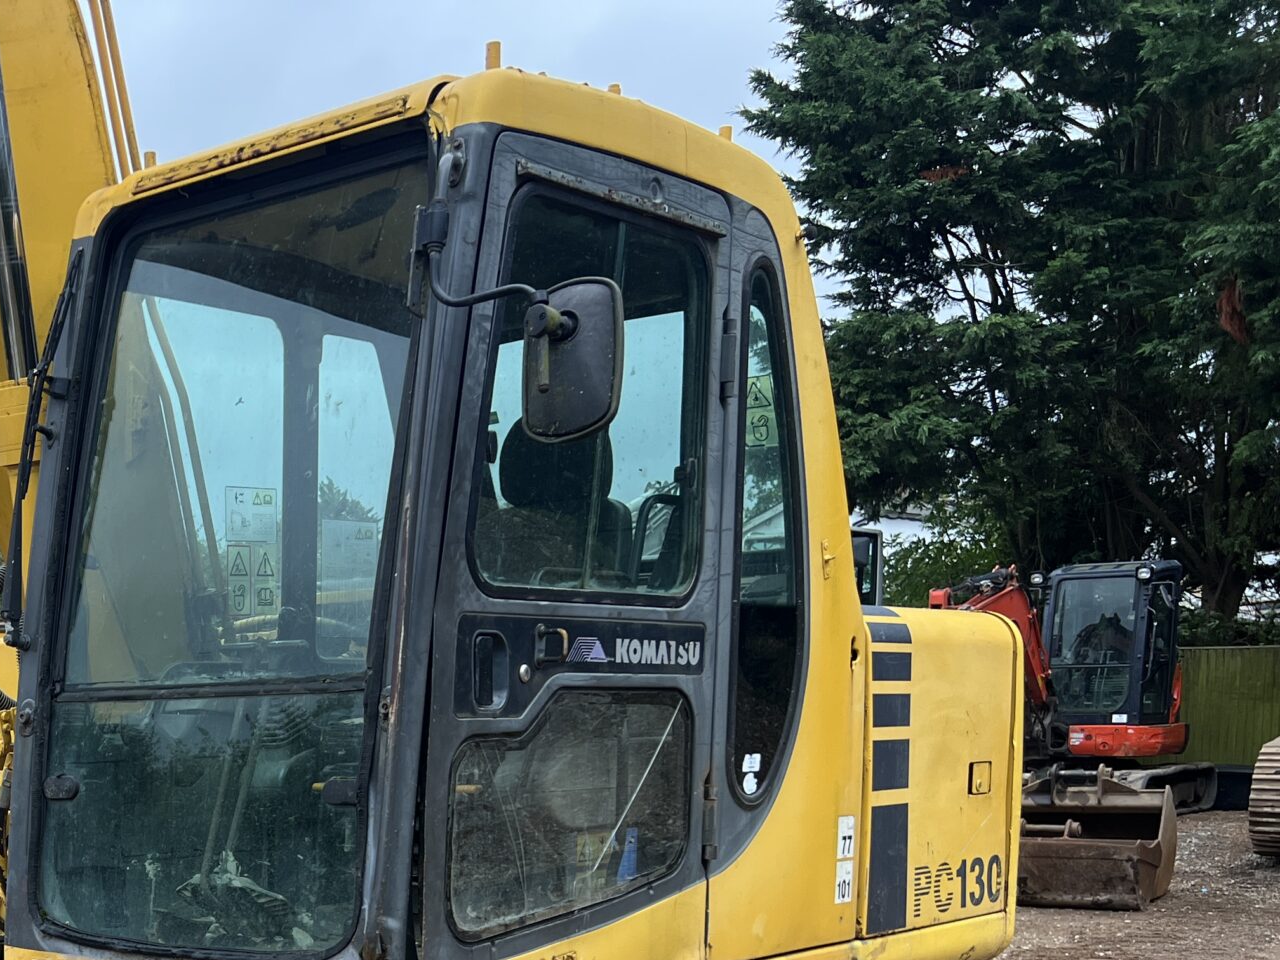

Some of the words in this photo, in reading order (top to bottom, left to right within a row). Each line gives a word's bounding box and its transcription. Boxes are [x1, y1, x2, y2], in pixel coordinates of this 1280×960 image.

[616, 638, 701, 666] KOMATSU
[841, 834, 853, 855] 77
[836, 879, 851, 900] 101
[913, 854, 1002, 918] PC130
